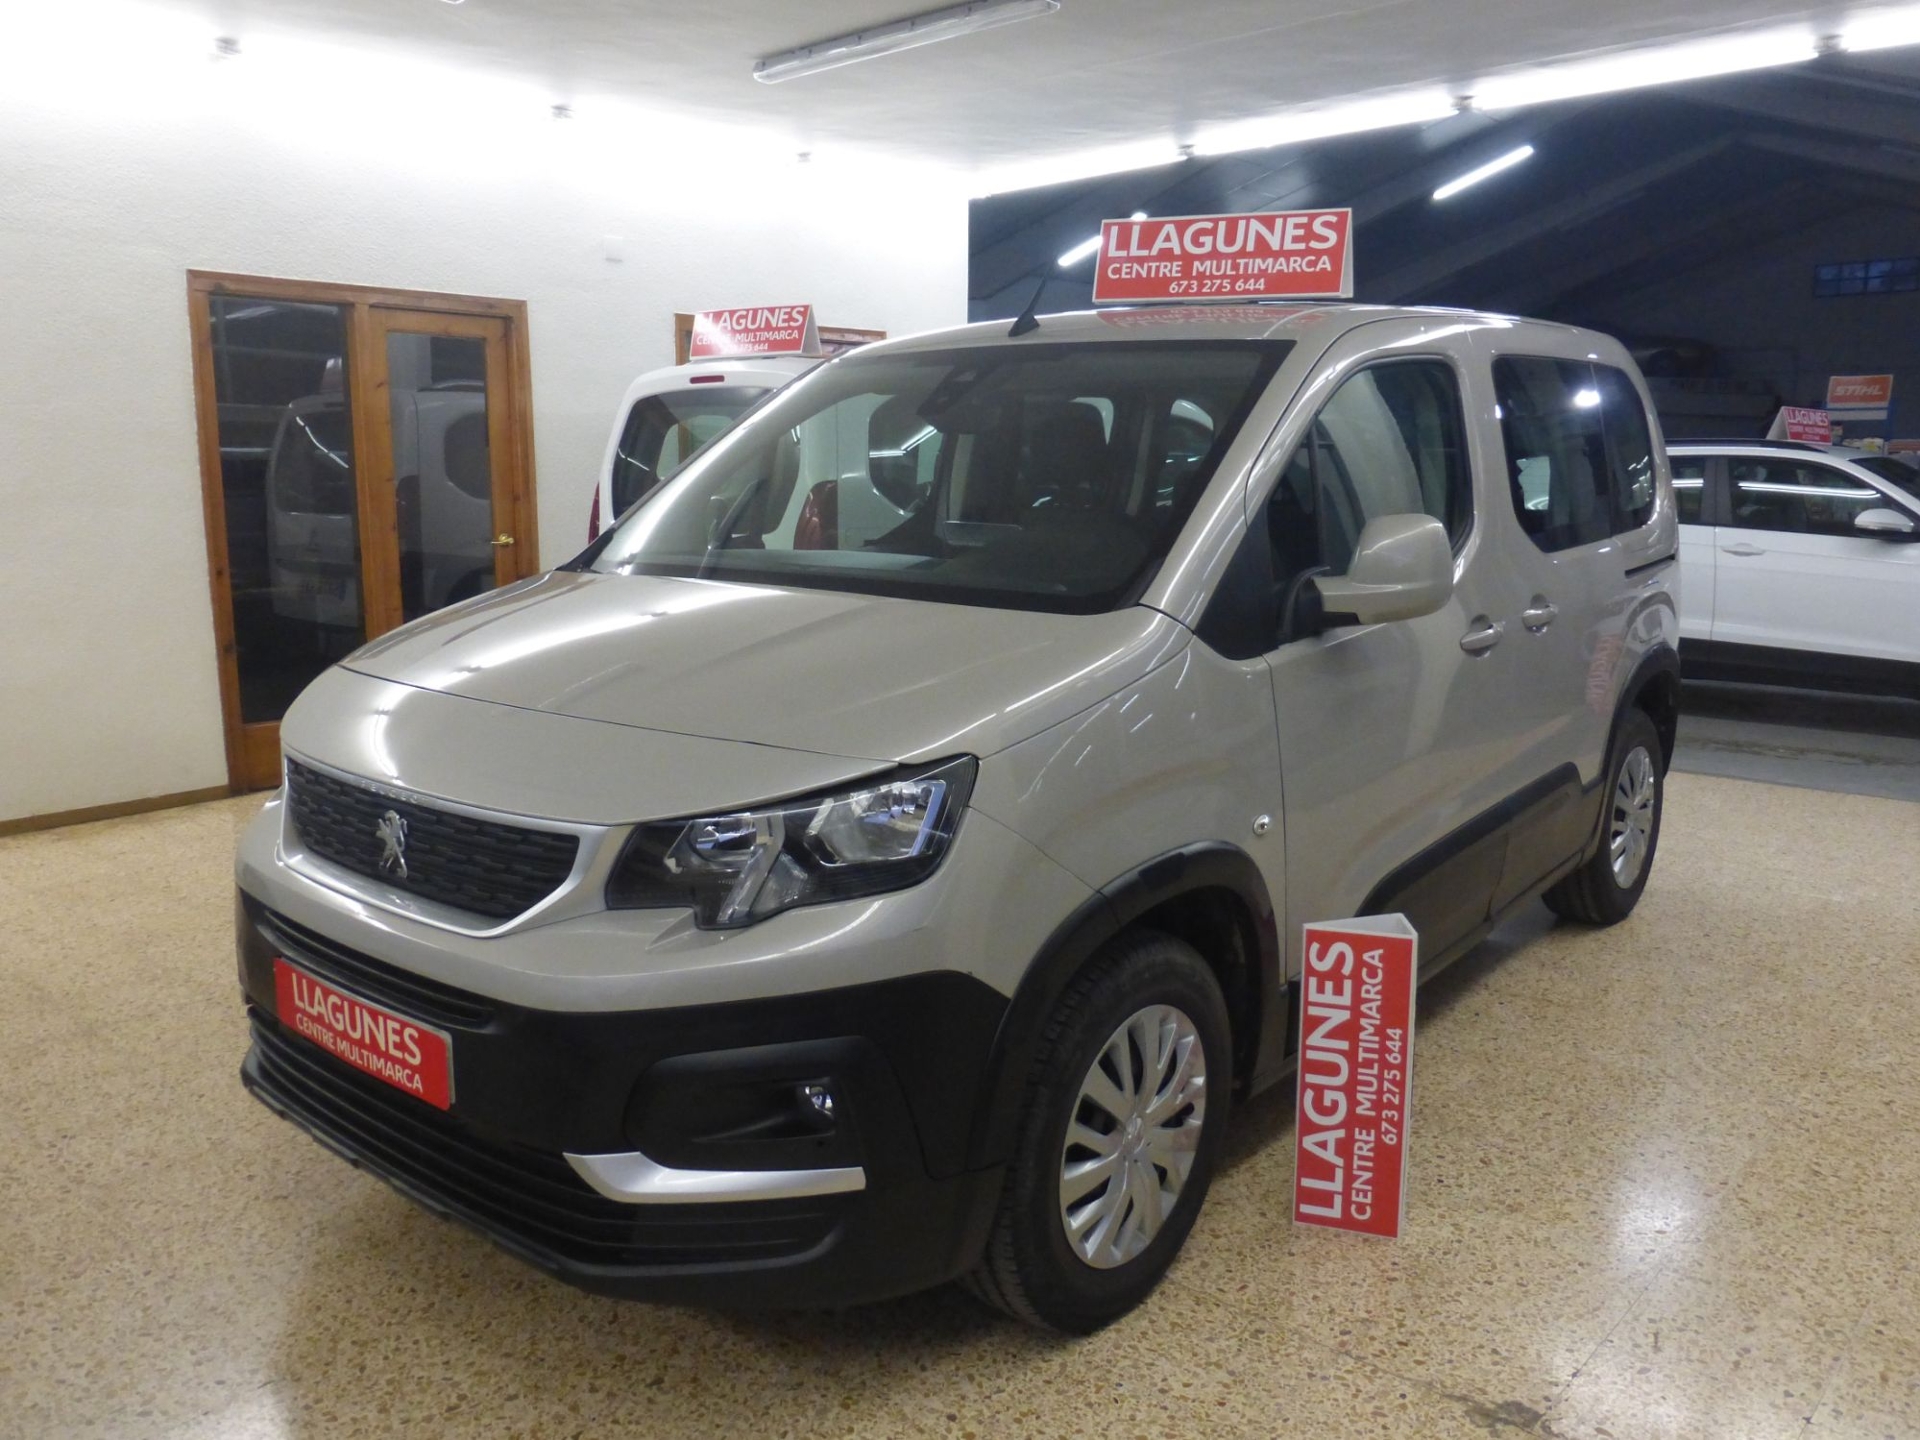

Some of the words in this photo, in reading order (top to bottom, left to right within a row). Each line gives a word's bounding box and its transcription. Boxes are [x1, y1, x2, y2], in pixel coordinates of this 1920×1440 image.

[1107, 214, 1339, 258] LLAGUNES
[1107, 261, 1182, 279] CENTRE
[1192, 255, 1332, 277] MULTIMARCA
[1169, 280, 1198, 294] 673
[1202, 279, 1231, 293] 275
[1235, 278, 1266, 292] 644
[697, 306, 805, 331] LAGUNES
[734, 330, 799, 343] MULTIMARCA
[1834, 385, 1883, 396] STIHL
[1787, 408, 1829, 426] LLAGUNES
[291, 972, 422, 1066] LLAGUNES
[1355, 948, 1384, 1116] MULTIMARCA
[296, 1012, 336, 1050] CENTRE
[336, 1040, 424, 1093] MULTIMARCA
[1386, 1028, 1403, 1063] 644
[1299, 941, 1354, 1219] LLAGUNES
[1383, 1069, 1400, 1107] 275
[1381, 1109, 1399, 1145] 673
[1351, 1127, 1375, 1221] CENTRE
